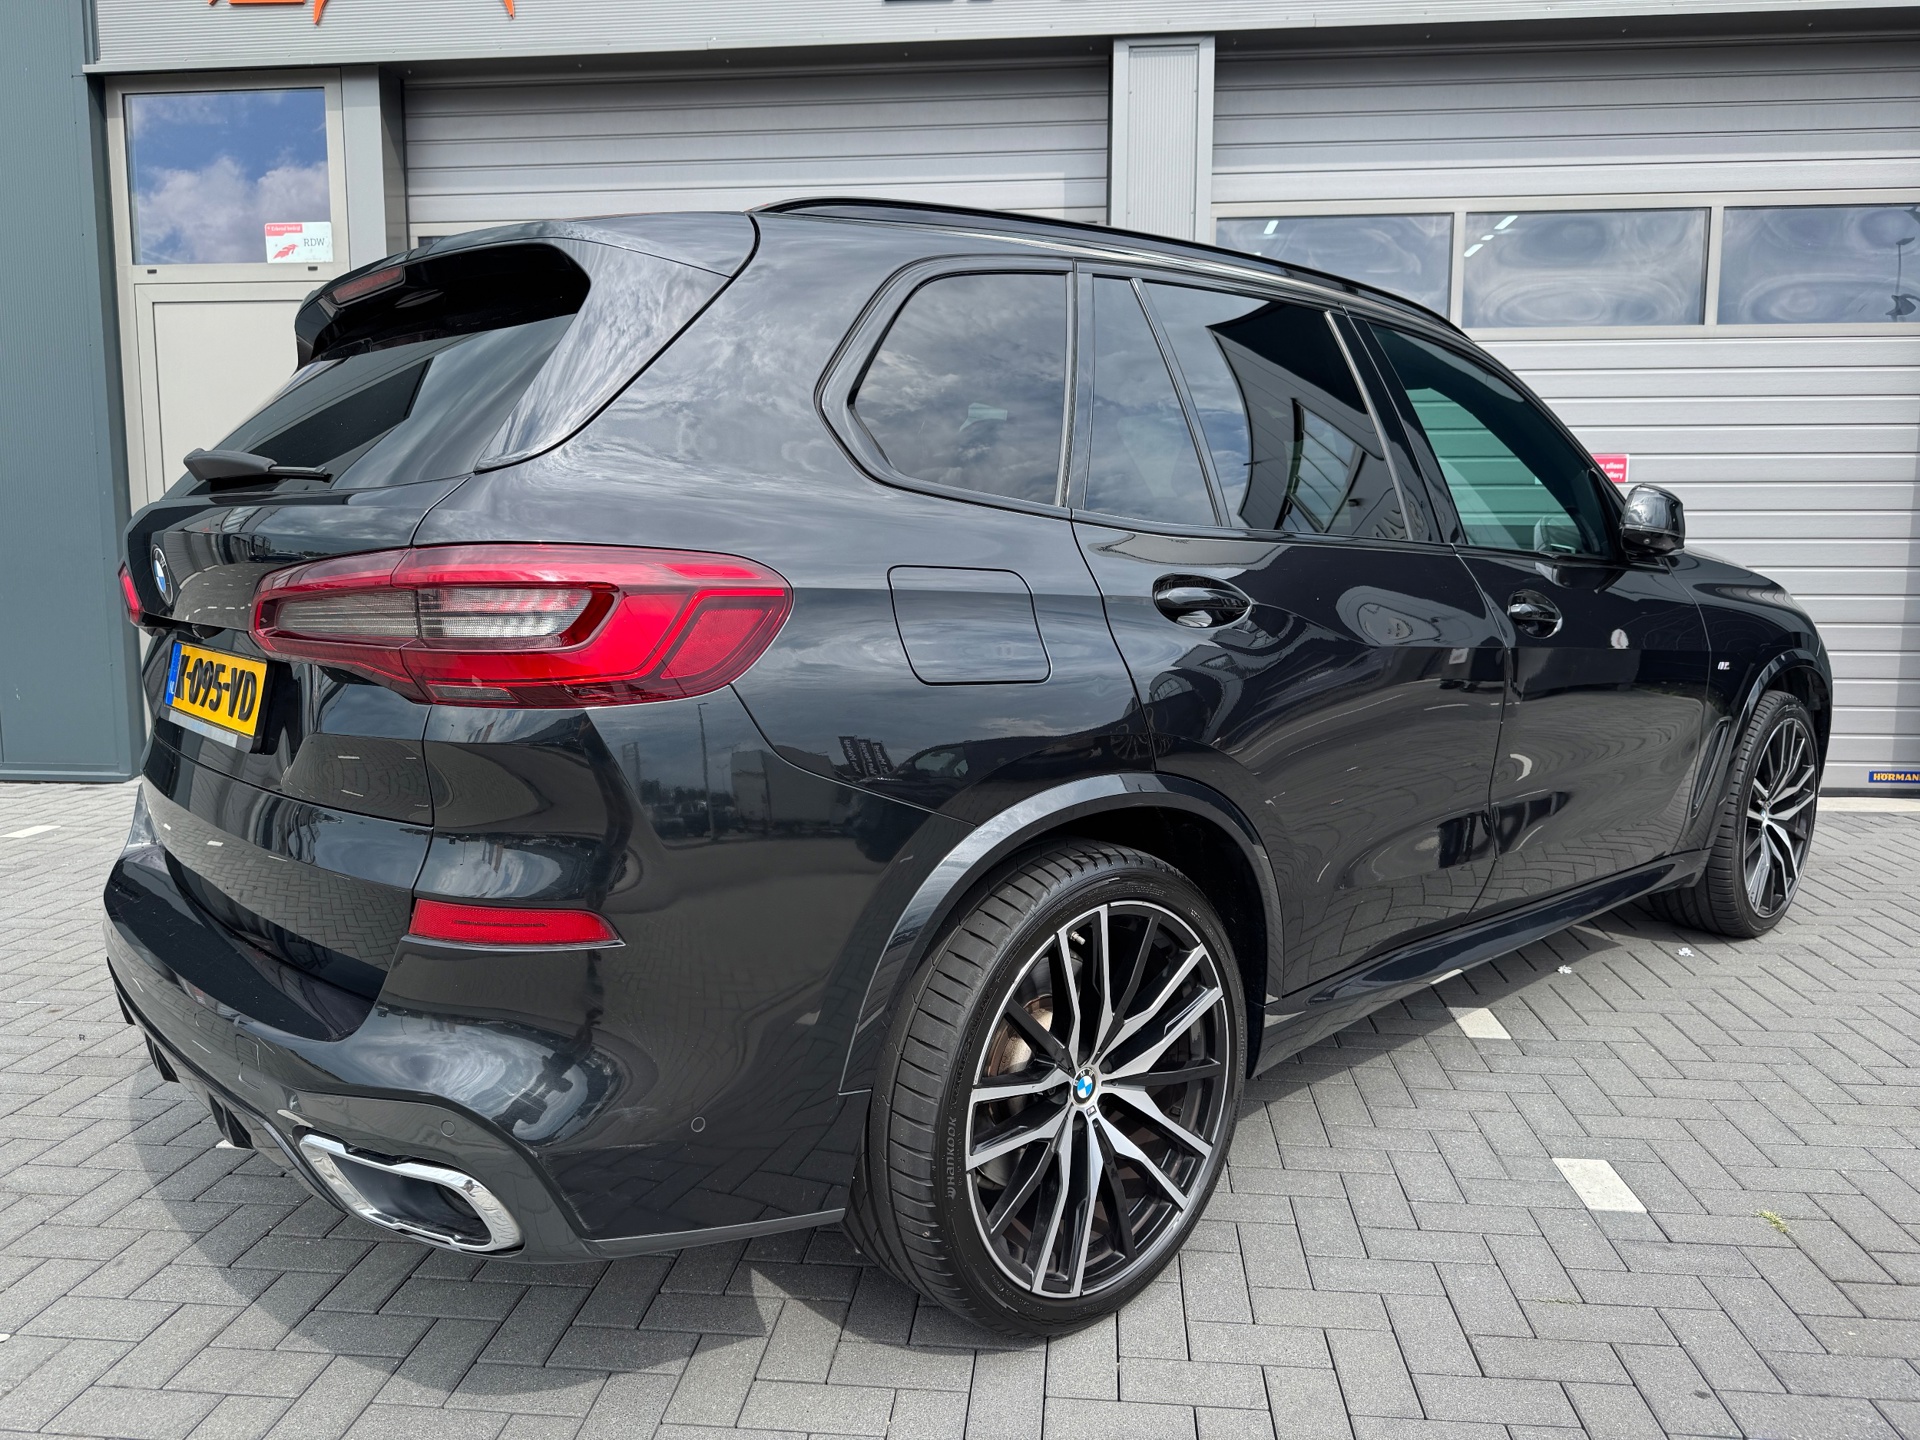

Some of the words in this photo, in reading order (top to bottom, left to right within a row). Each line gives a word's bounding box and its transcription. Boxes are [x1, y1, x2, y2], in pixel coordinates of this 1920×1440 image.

[303, 238, 325, 247] RDW
[174, 654, 258, 722] K-095-VD
[1873, 772, 1920, 782] HÖRMAN
